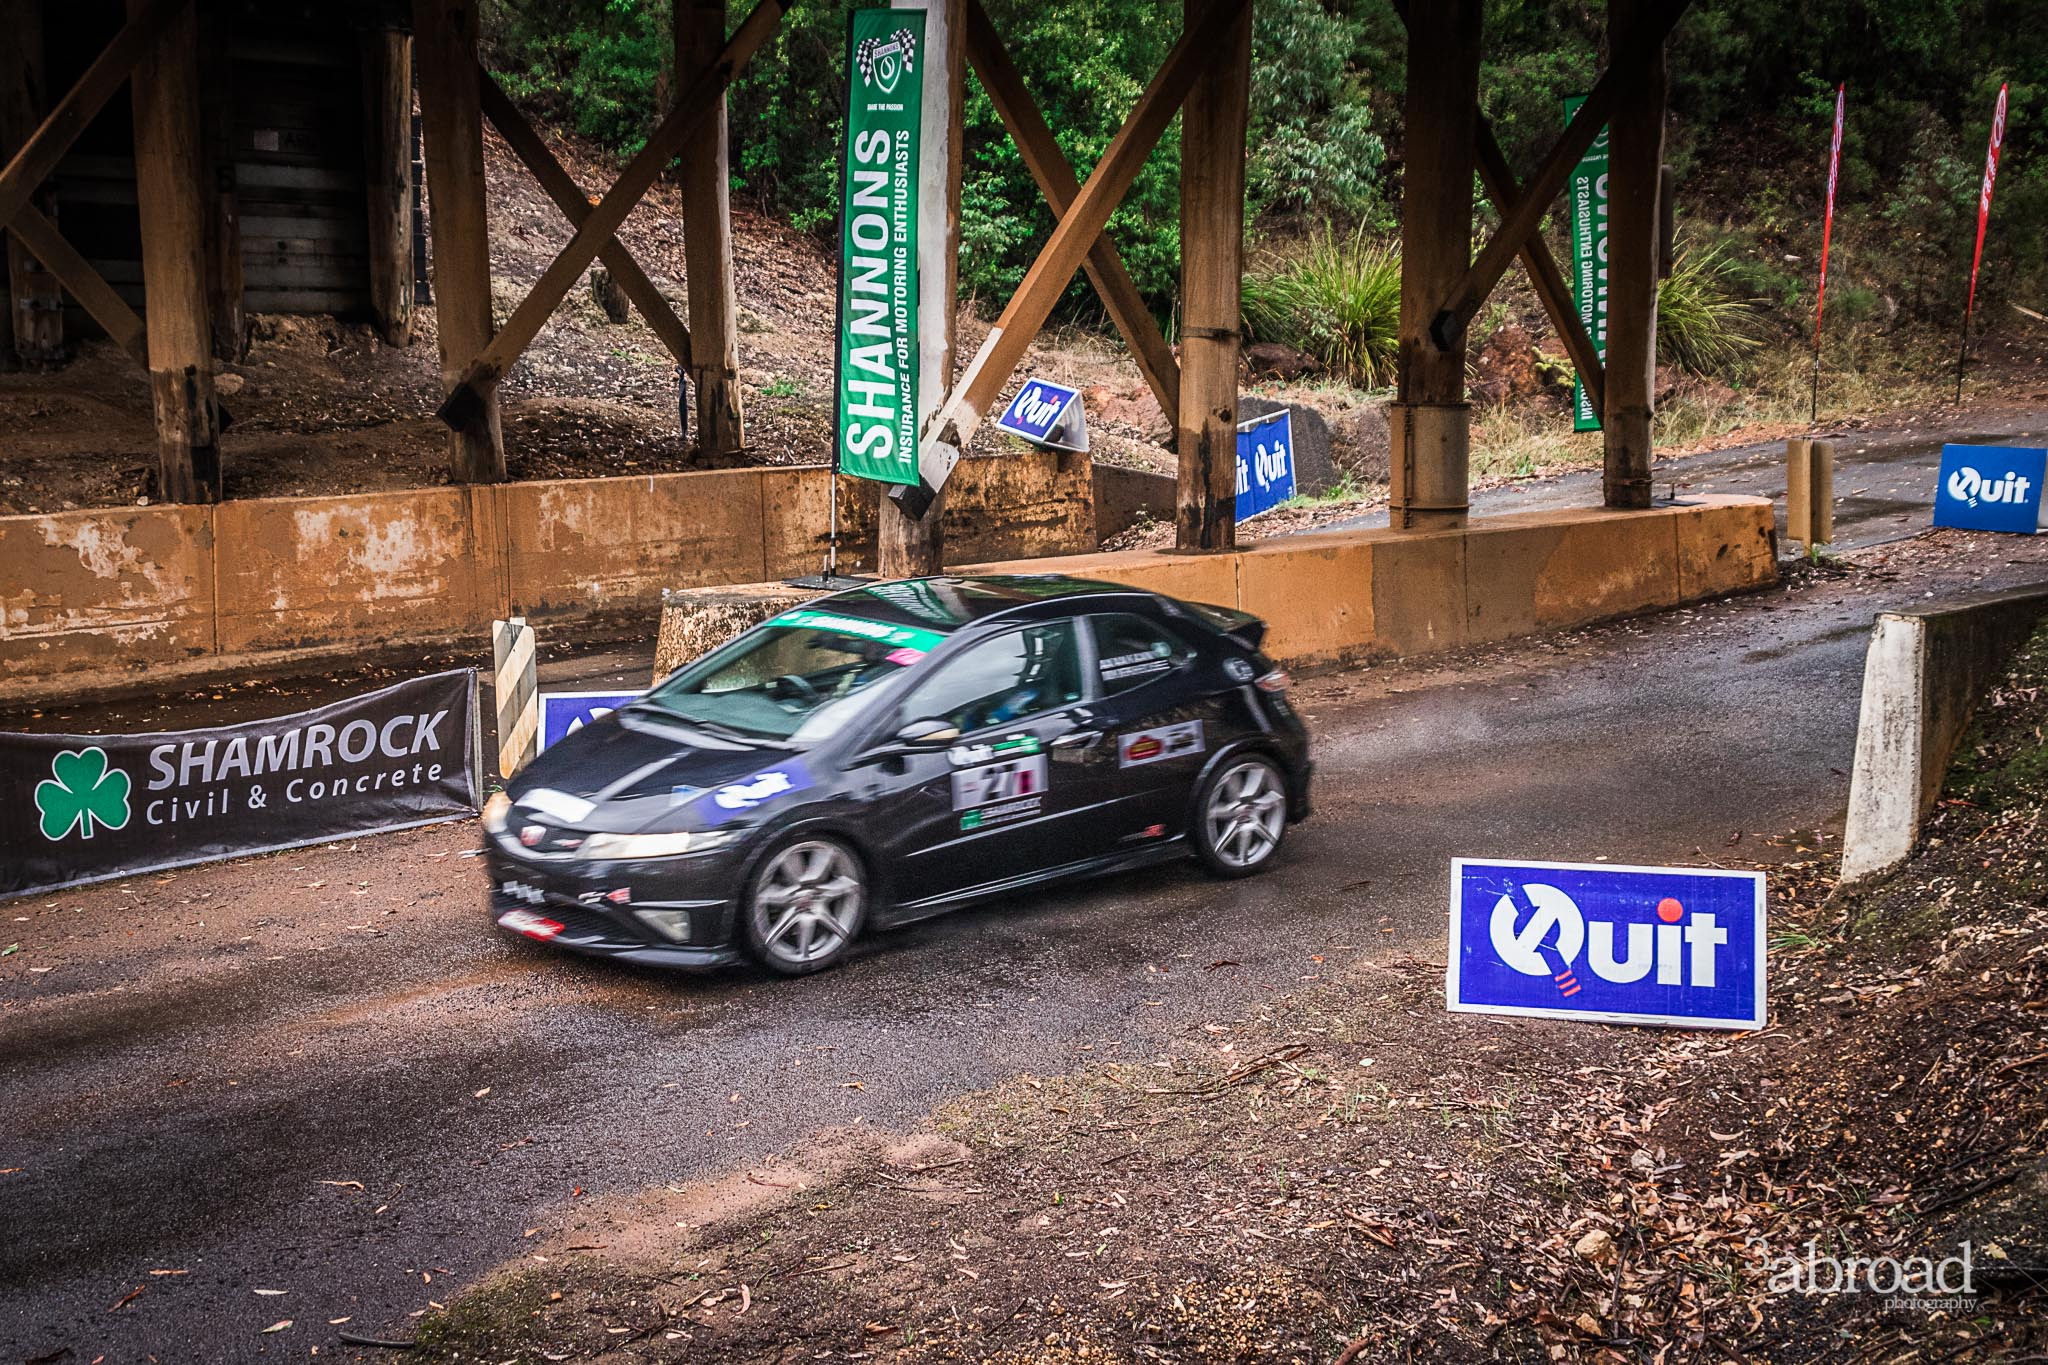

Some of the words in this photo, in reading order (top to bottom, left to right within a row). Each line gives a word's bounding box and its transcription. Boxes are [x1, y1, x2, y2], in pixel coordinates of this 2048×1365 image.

[894, 130, 910, 243] ENTHUSIASTS
[846, 129, 896, 459] SHANNONS
[893, 246, 908, 333] MOTORING
[898, 337, 909, 369] FOR
[898, 371, 912, 464] INSURANCE
[1014, 386, 1061, 427] Quit
[1948, 466, 2030, 508] Quit
[148, 709, 448, 791] SHAMROCK
[146, 790, 228, 825] Civil
[248, 784, 267, 810] &
[286, 762, 442, 803] Concrete
[1489, 883, 1727, 998] Quit
